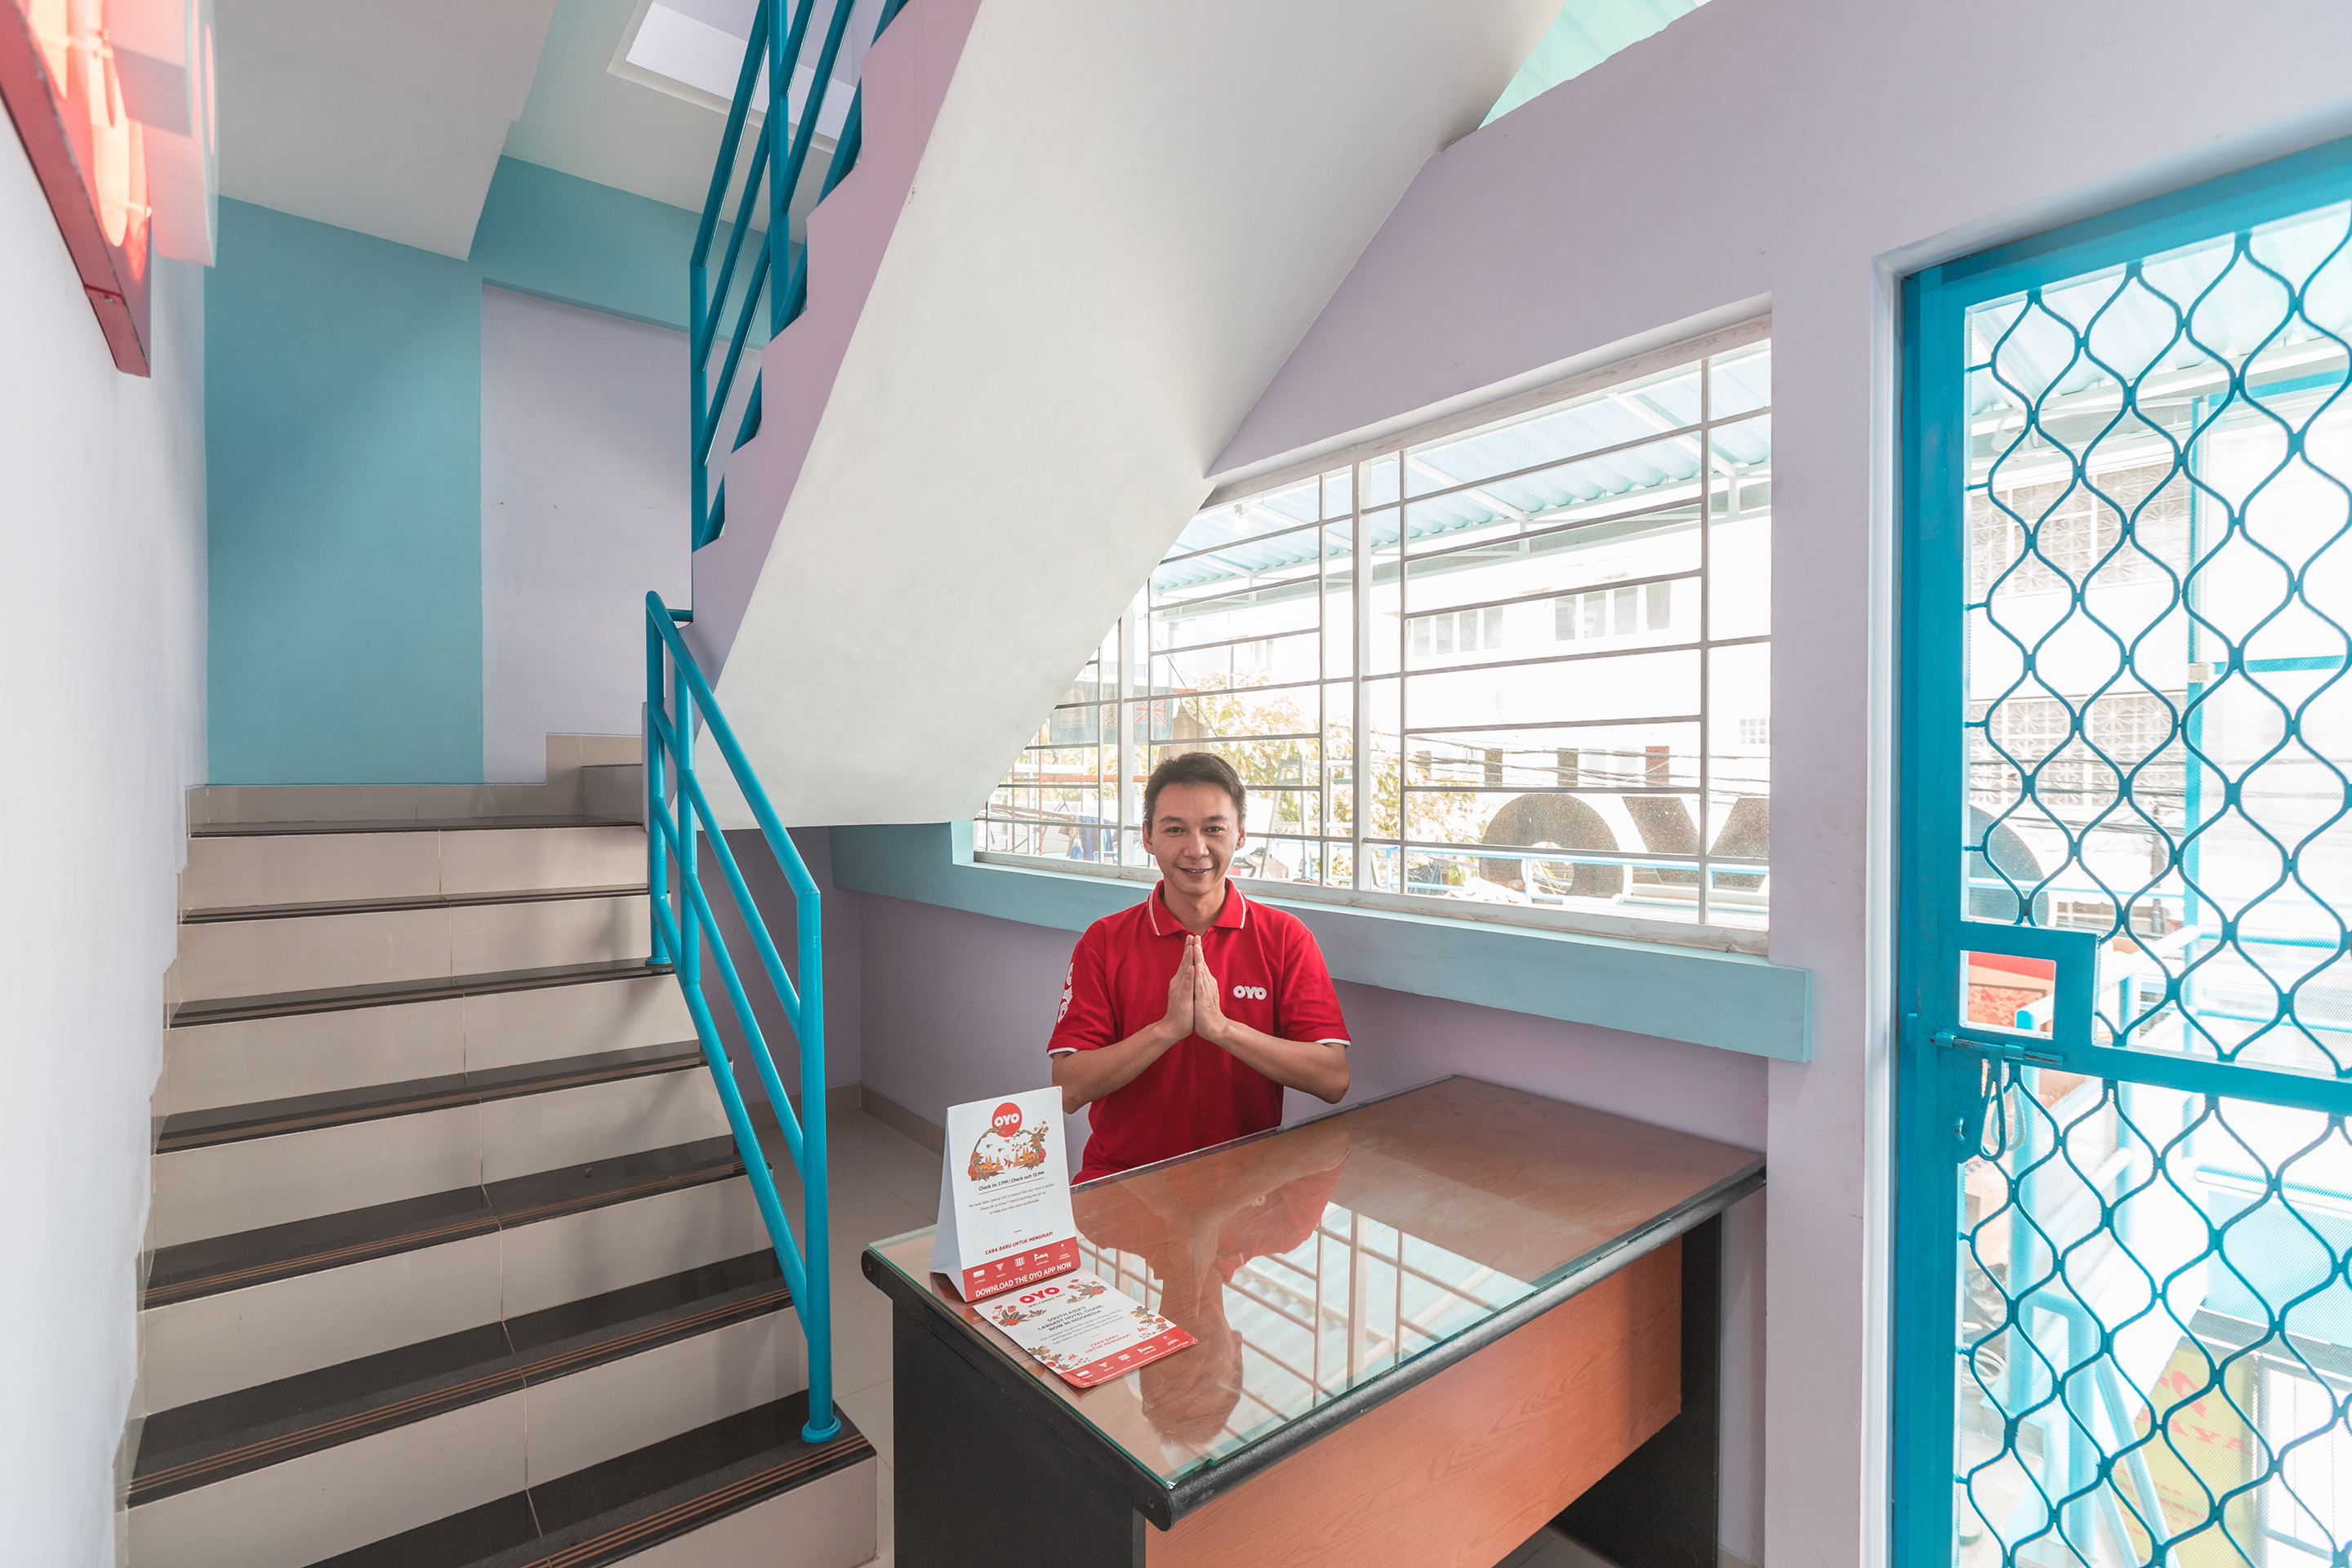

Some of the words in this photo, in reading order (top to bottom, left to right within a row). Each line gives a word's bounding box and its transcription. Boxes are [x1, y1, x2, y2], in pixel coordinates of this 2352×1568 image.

[1233, 985, 1267, 1000] OYO
[994, 1112, 1020, 1127] OYO
[1012, 1239, 1027, 1247] UNTUK
[1028, 1232, 1053, 1242] MENGINAP!
[975, 1280, 1013, 1298] DOWNLOAD
[1014, 1275, 1028, 1285] THE
[1028, 1271, 1042, 1281] OYO
[1044, 1266, 1056, 1276] APP
[1057, 1261, 1071, 1272] NOW
[1019, 1287, 1060, 1304] OYO
[1037, 1319, 1063, 1330] LARGEST
[1064, 1312, 1084, 1321] HOTEL
[1047, 1312, 1068, 1322] SOUTH
[1068, 1306, 1086, 1315] ASIA'S
[1071, 1310, 1102, 1323] INDONESIA
[1085, 1344, 1102, 1353] UNTUK
